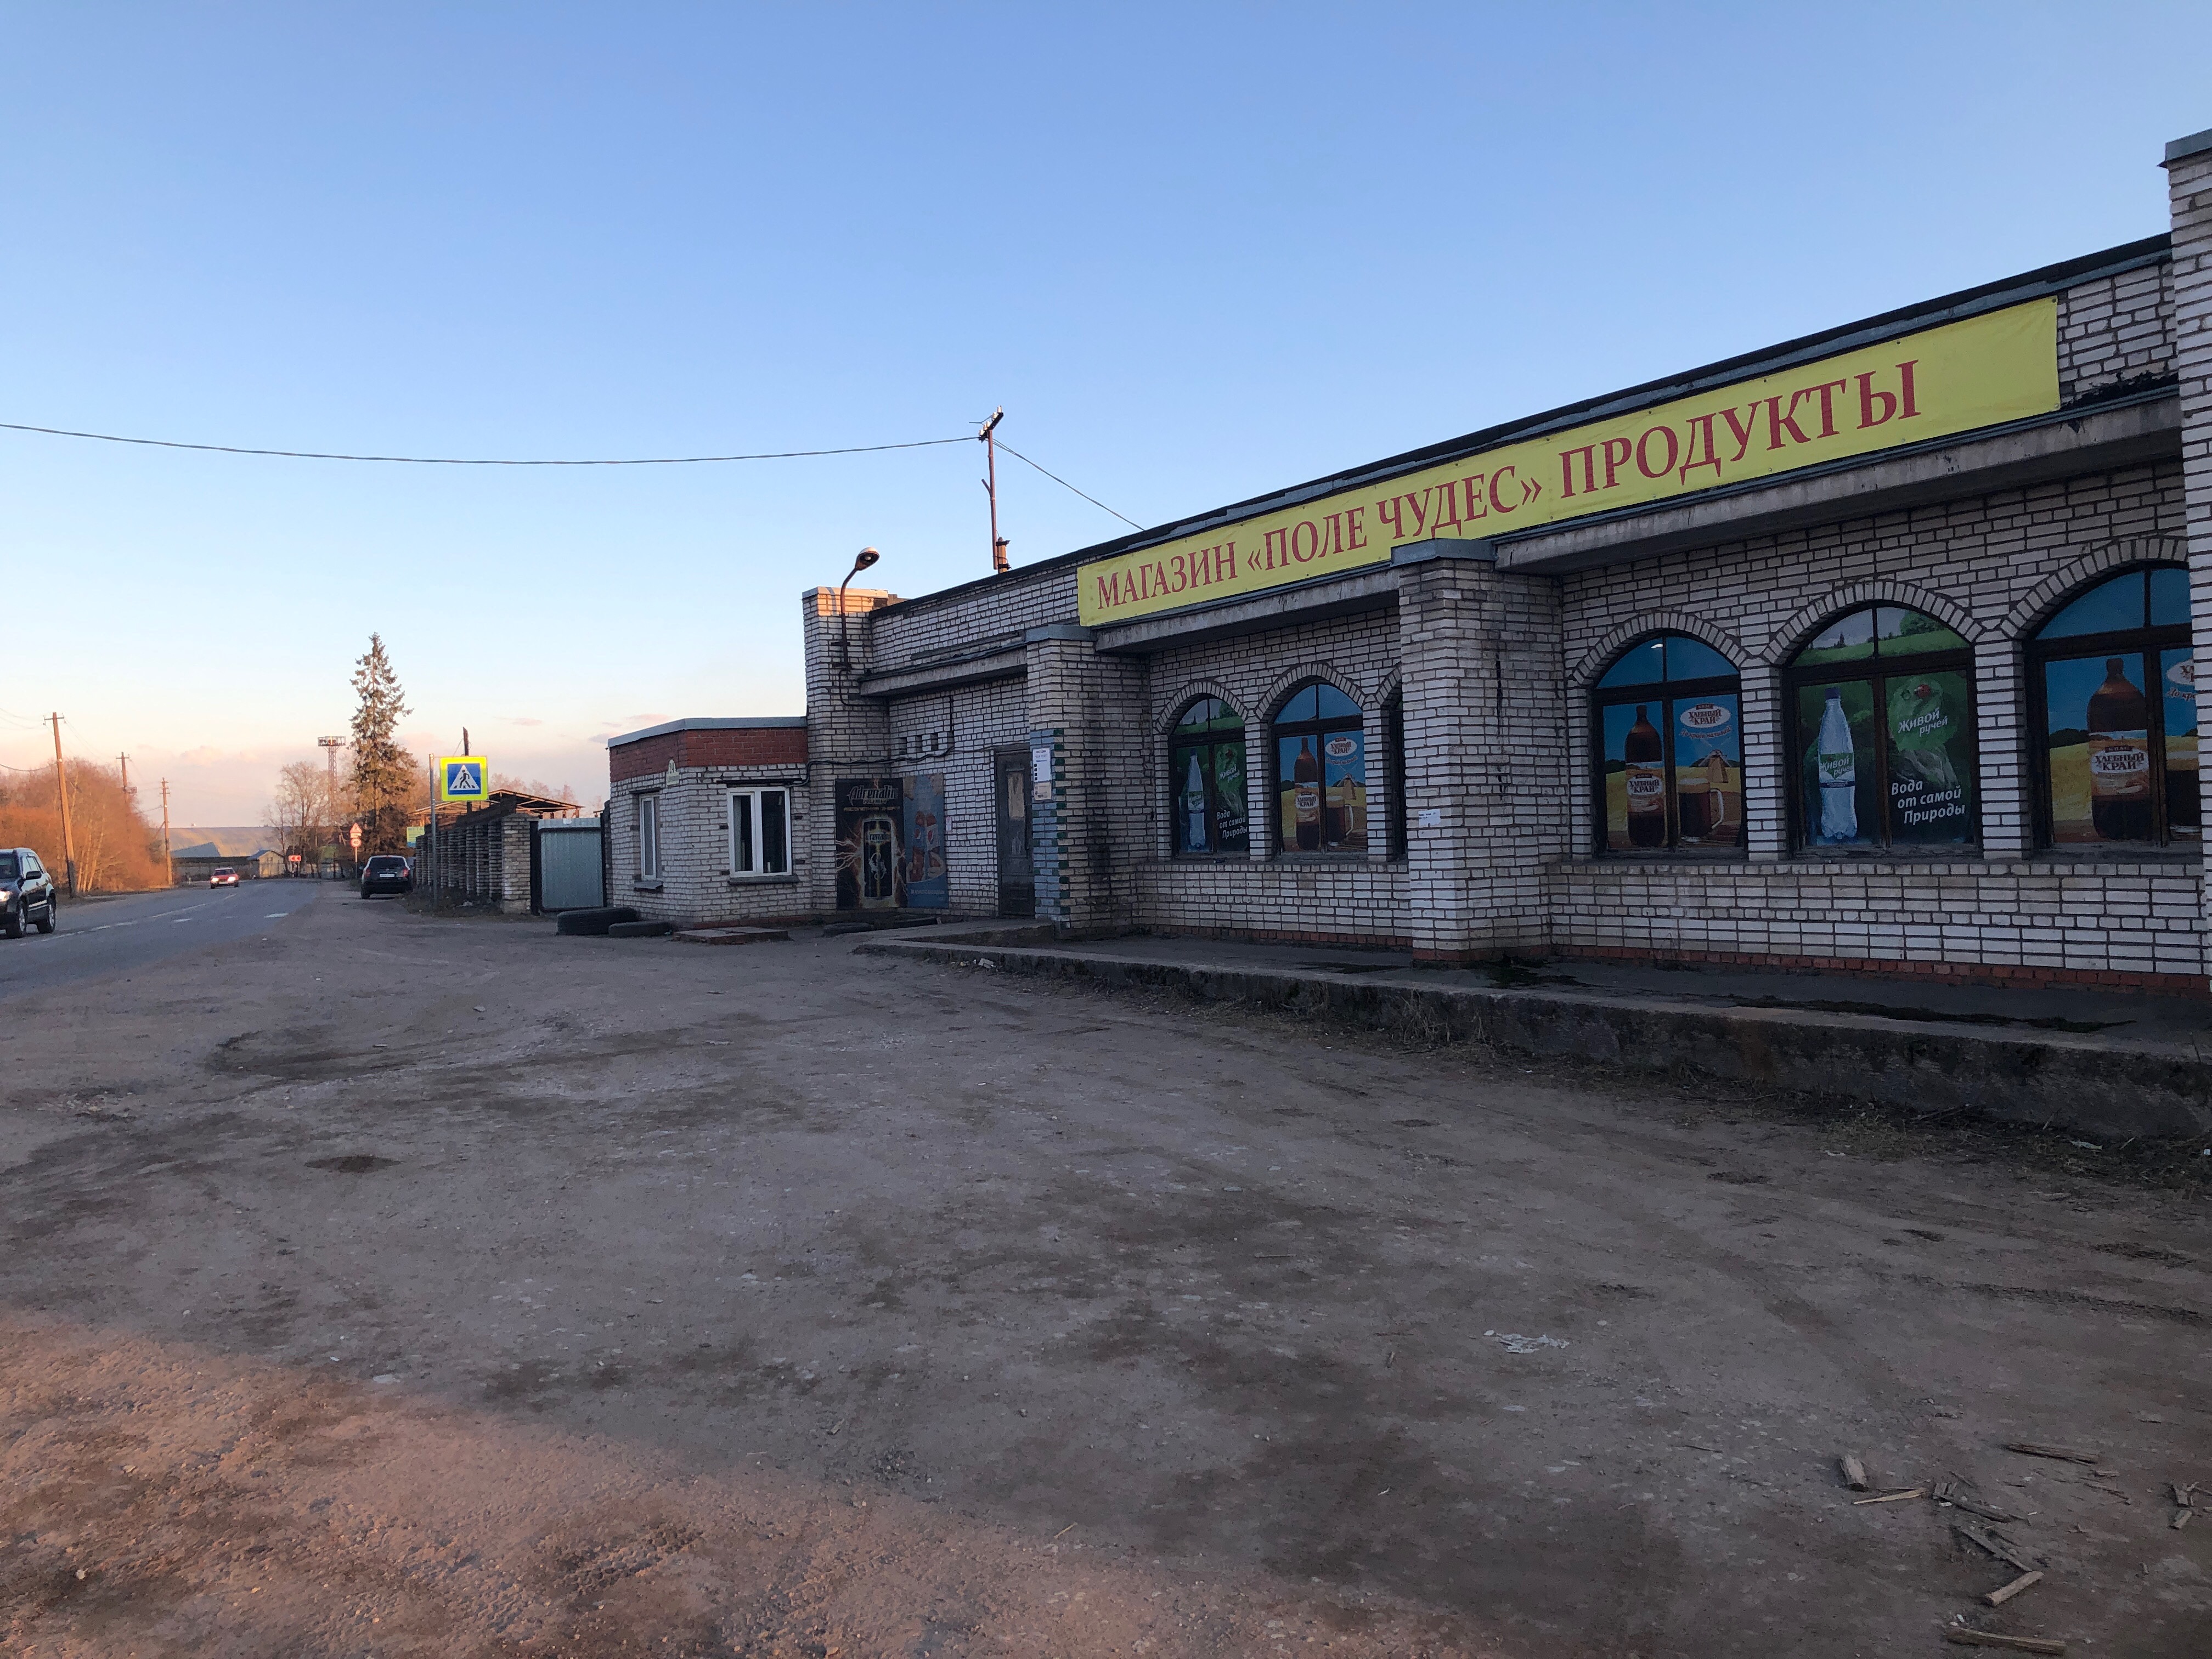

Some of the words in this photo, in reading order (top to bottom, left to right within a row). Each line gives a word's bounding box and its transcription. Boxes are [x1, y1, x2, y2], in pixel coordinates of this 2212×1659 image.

[1097, 541, 1238, 610] МАГАЗИН
[1246, 507, 1367, 572] «ПОЛЕ
[1376, 465, 1543, 538] ЧУДЕС»
[1559, 359, 1921, 499] ПРОДУКТЫ
[1919, 715, 1948, 737] ручей
[2095, 752, 2145, 764] ХЛЕБНЫЙ
[1891, 779, 1923, 795] Вода
[1898, 797, 1916, 809] от
[1920, 785, 1962, 805] самой
[1217, 810, 1231, 820] Вода
[1219, 821, 1228, 829] от
[1229, 814, 1246, 827] самой
[1904, 803, 1966, 826] Природы
[1222, 826, 1248, 839] Природы
